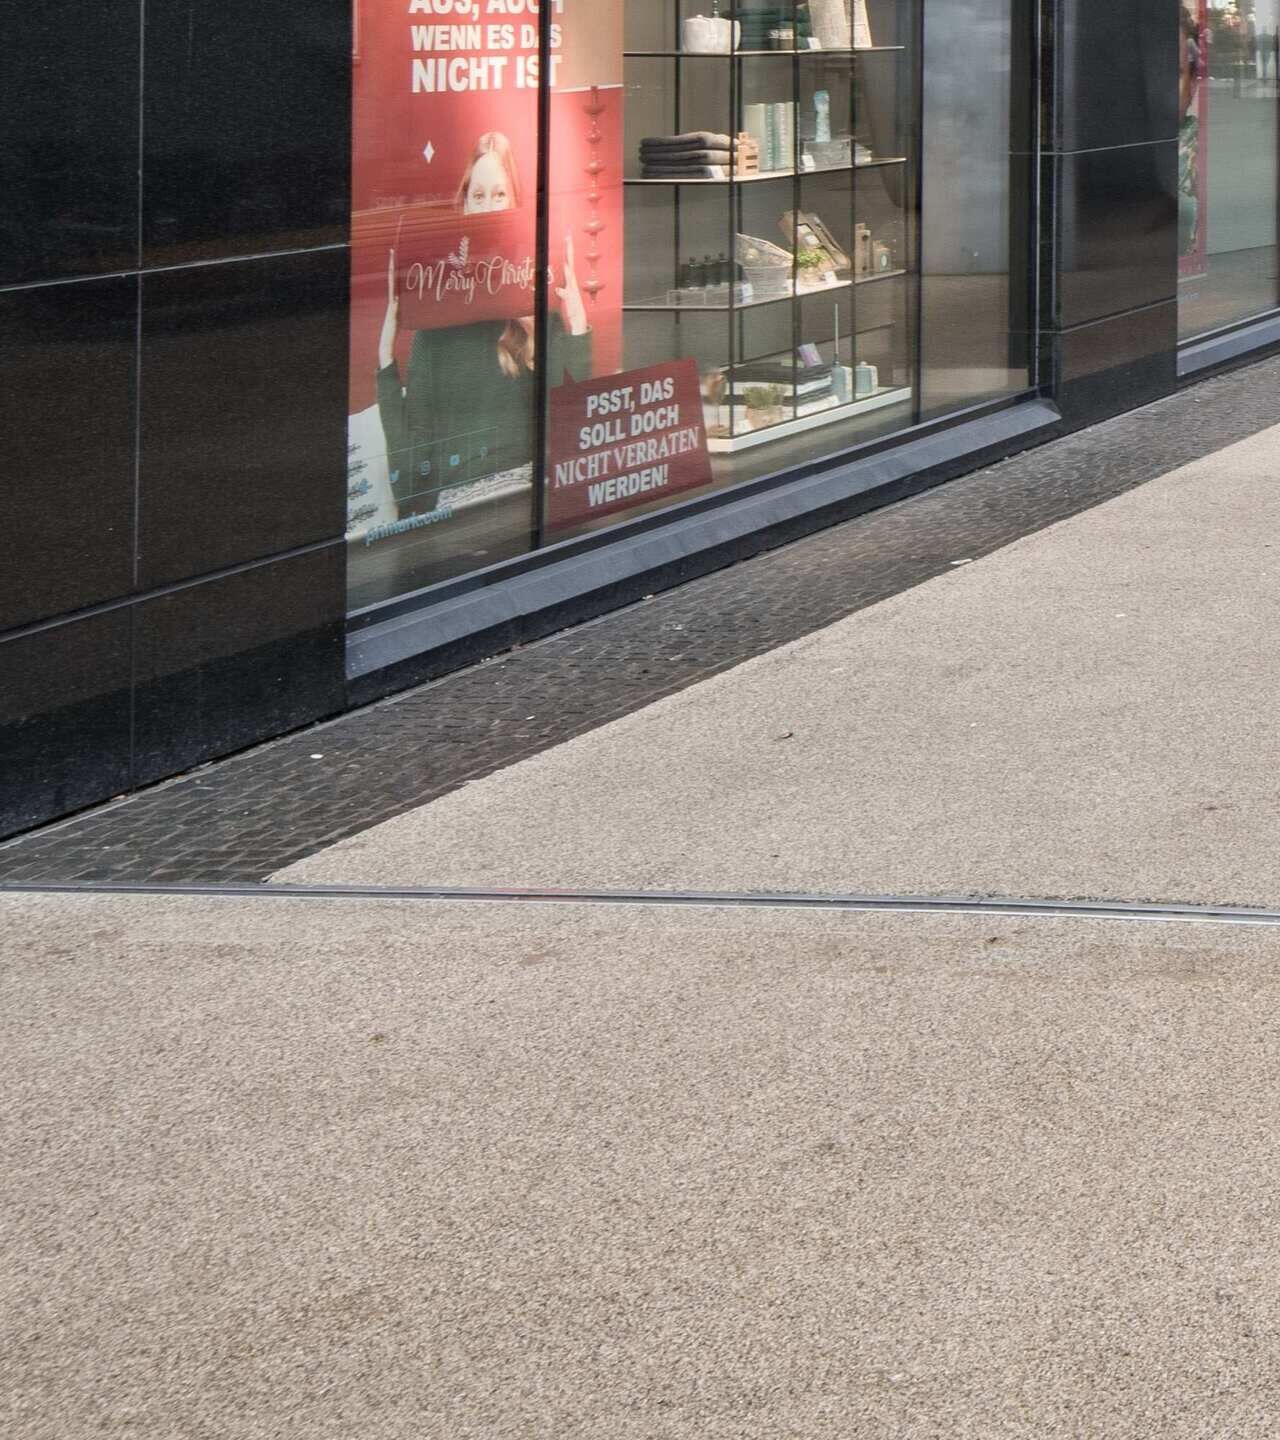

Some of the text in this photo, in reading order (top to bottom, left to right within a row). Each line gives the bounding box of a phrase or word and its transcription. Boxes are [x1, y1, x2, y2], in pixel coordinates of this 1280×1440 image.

[411, 24, 563, 52] WENN ES DS
[411, 55, 563, 93] NICHT IST
[406, 255, 554, 305] Merry Christs
[586, 377, 674, 418] PSST, DAS
[579, 404, 680, 450] SOLL DOCH
[554, 426, 701, 489] NICHT VERRATEN
[588, 463, 669, 507] WERDEN!
